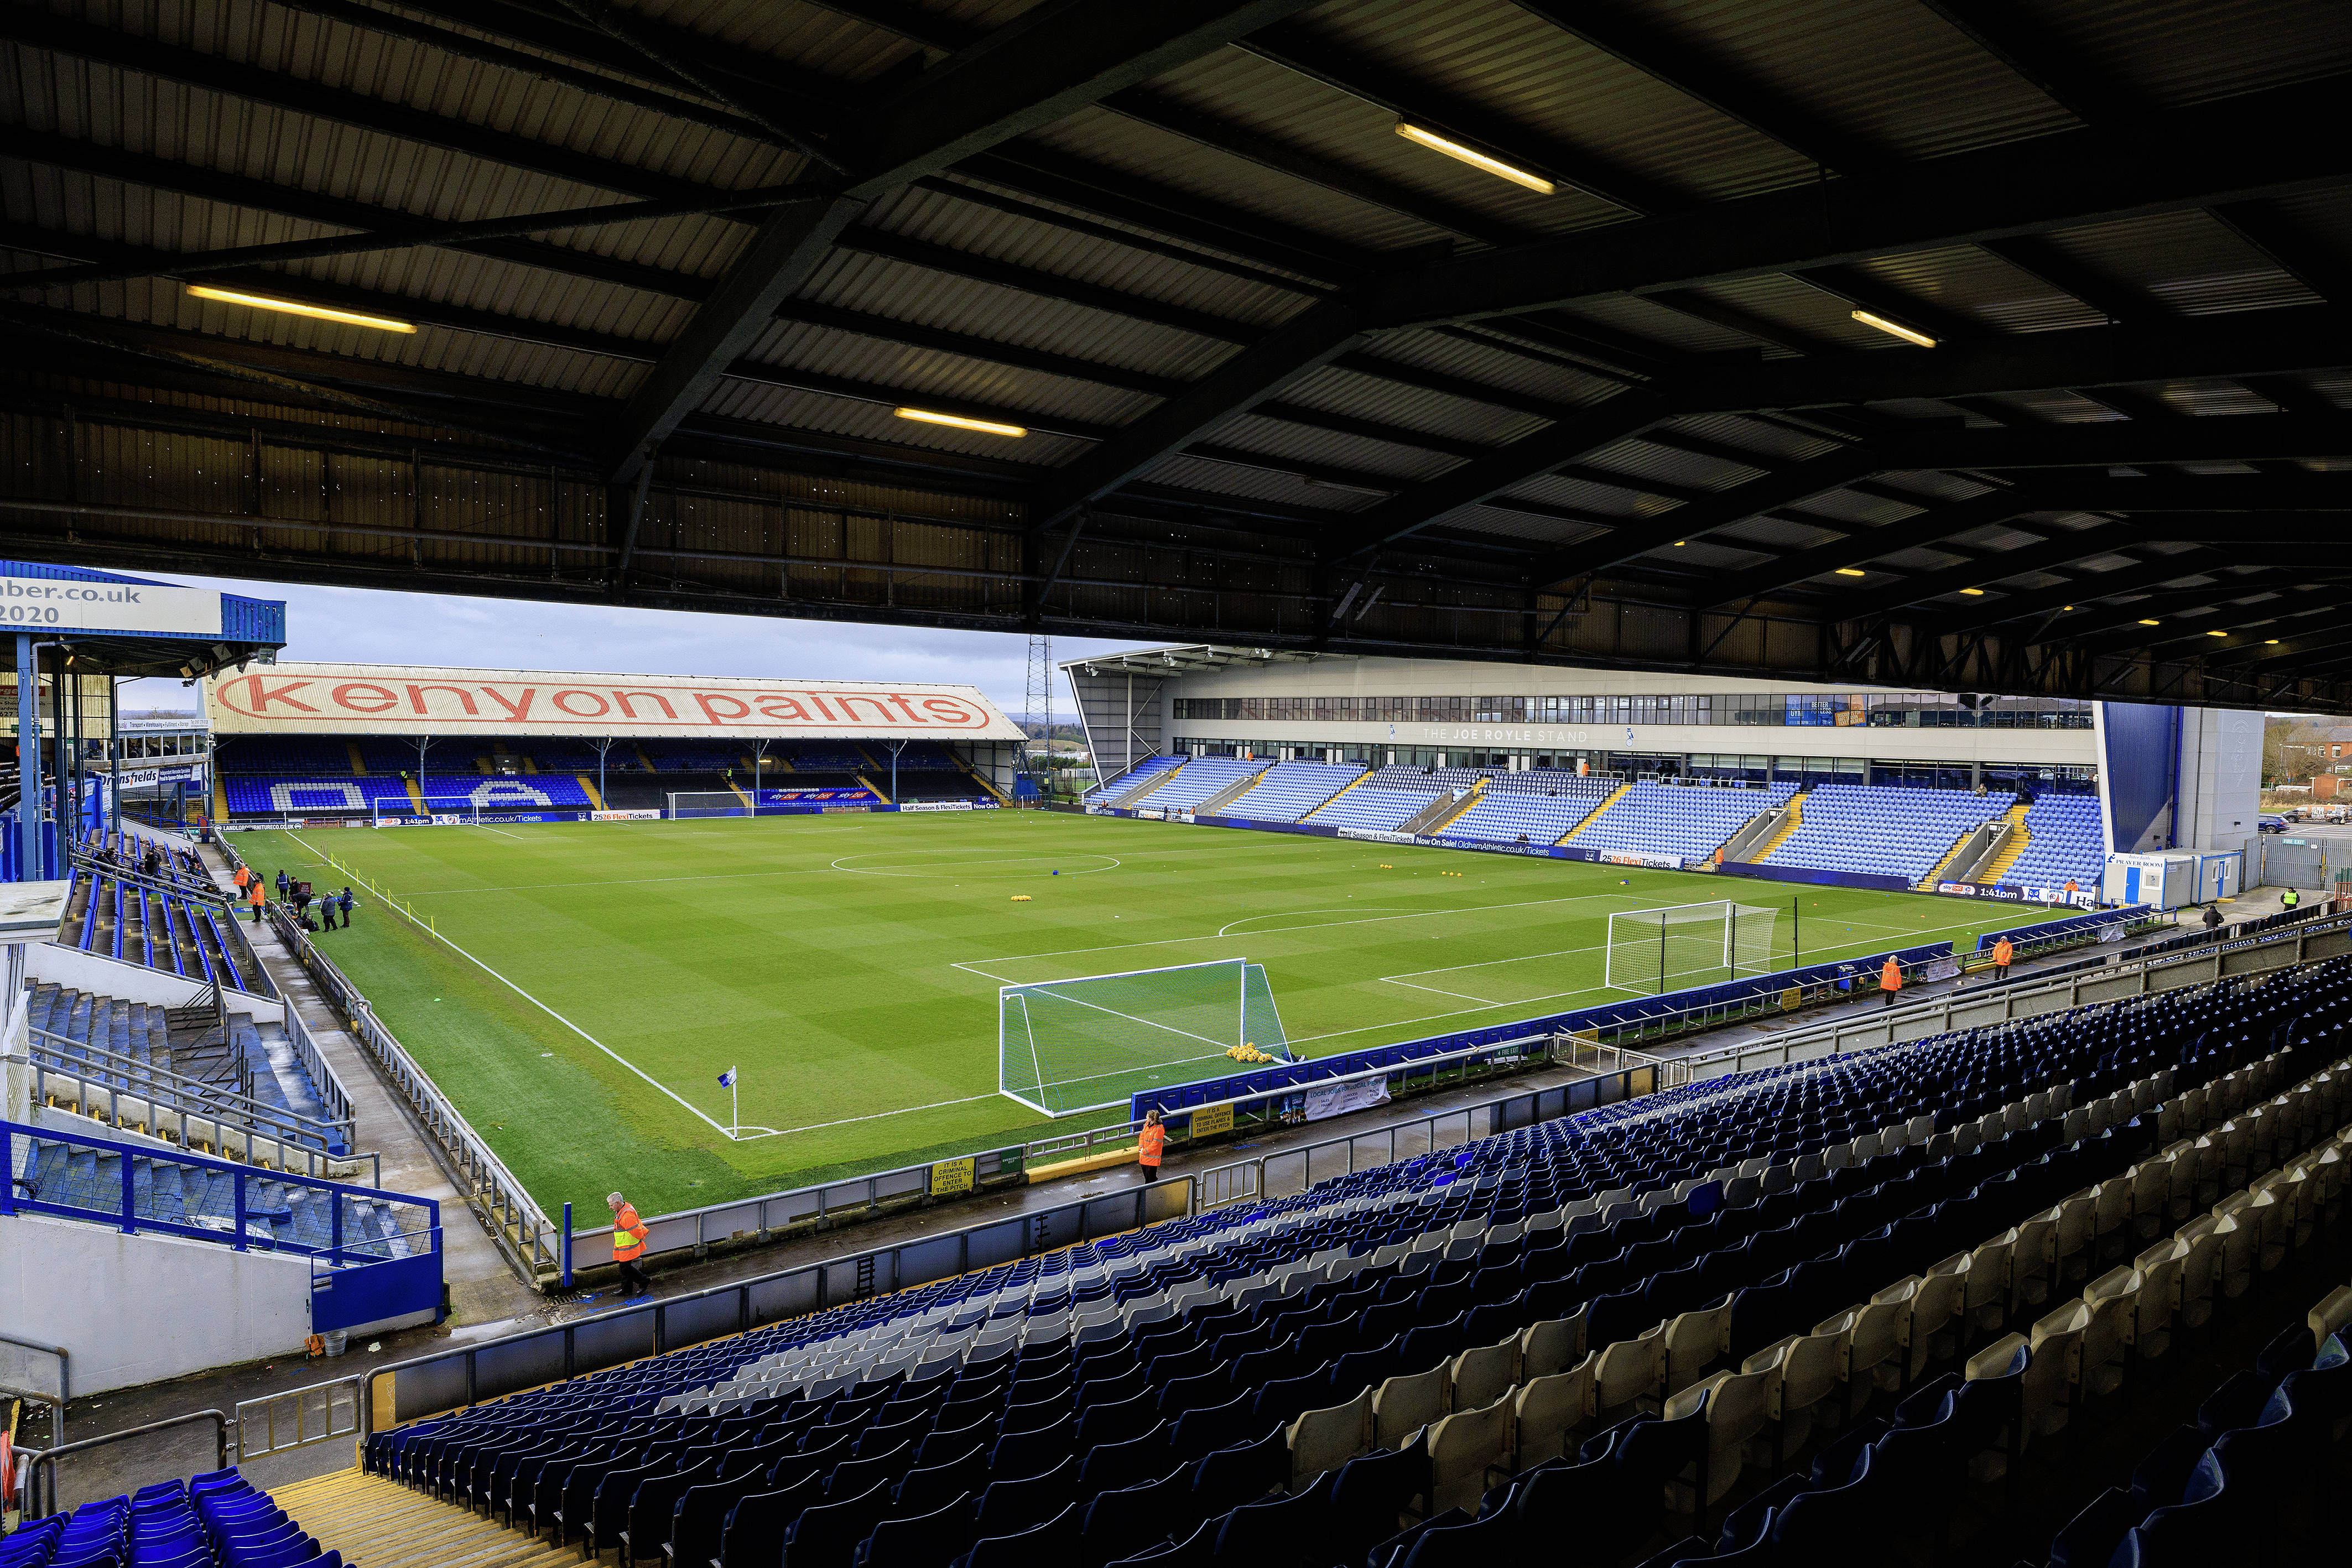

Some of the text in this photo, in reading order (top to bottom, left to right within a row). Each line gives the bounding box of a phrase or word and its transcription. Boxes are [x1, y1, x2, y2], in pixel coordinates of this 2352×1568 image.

[0, 580, 141, 603] ber.co.uk
[247, 675, 971, 726] kenyon paints
[1423, 729, 1588, 742] THE JOE ROYLE STAND
[102, 770, 157, 785] Drnsfields
[1352, 831, 1372, 840] Season
[1379, 833, 1413, 843] FlexiTickets
[1441, 839, 1457, 847] Sale!
[1458, 840, 1549, 856] OldhamAthletic.co.uk/Tickets
[1602, 855, 1671, 868] 2526 FlexiTickets
[1980, 888, 2017, 899] 1:41pm
[2077, 896, 2094, 907] Ha
[934, 1173, 961, 1182] OFFENCE
[943, 1178, 962, 1186] ENTER
